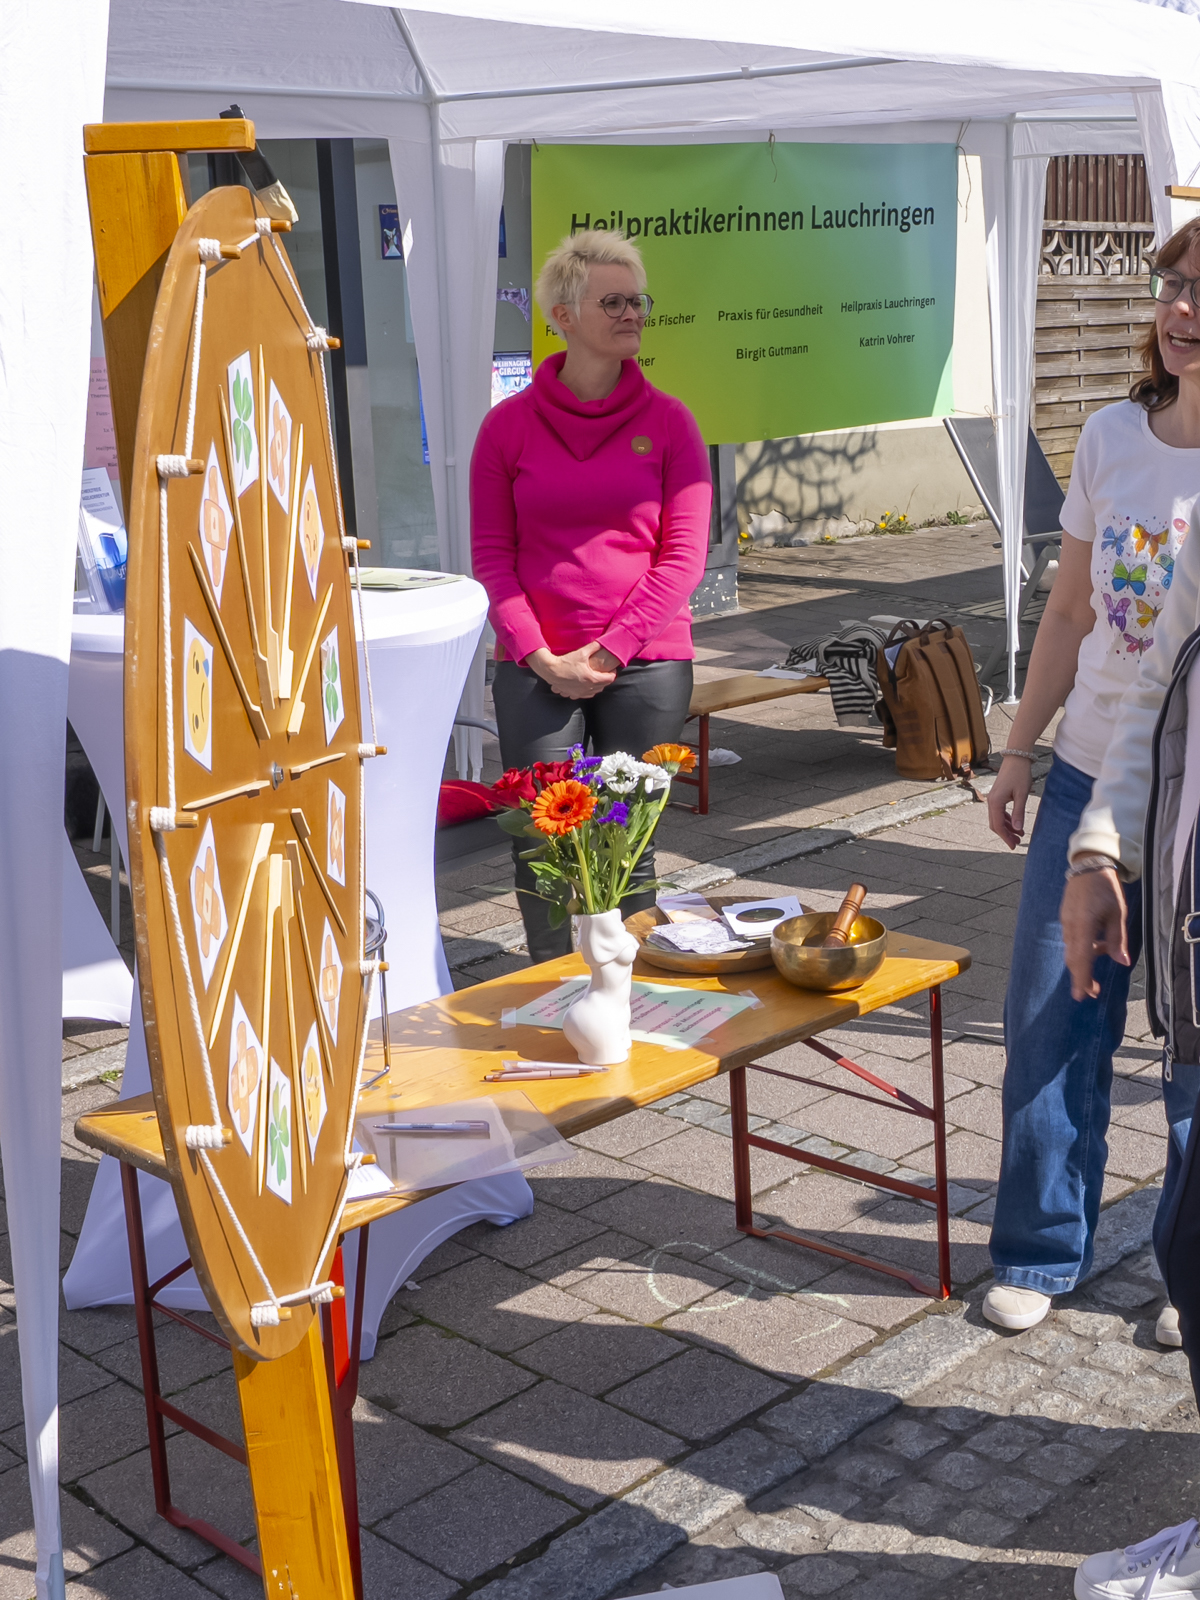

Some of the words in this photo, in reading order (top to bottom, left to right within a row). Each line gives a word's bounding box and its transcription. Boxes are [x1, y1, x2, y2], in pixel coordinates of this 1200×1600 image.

[570, 205, 804, 240] Heilpraktikerinnen
[811, 201, 935, 233] Lauchringen
[718, 309, 753, 321] Praxis
[756, 308, 770, 320] für
[772, 304, 823, 318] Gesundheit
[840, 299, 882, 314] Heilpraxis
[884, 296, 936, 311] Lauchringen
[659, 313, 696, 327] Fischer
[859, 335, 885, 348] Katrin
[887, 333, 916, 345] Vohrer
[736, 347, 766, 362] Birgit
[768, 344, 809, 357] Gutmann
[499, 367, 526, 376] CIRCUS
